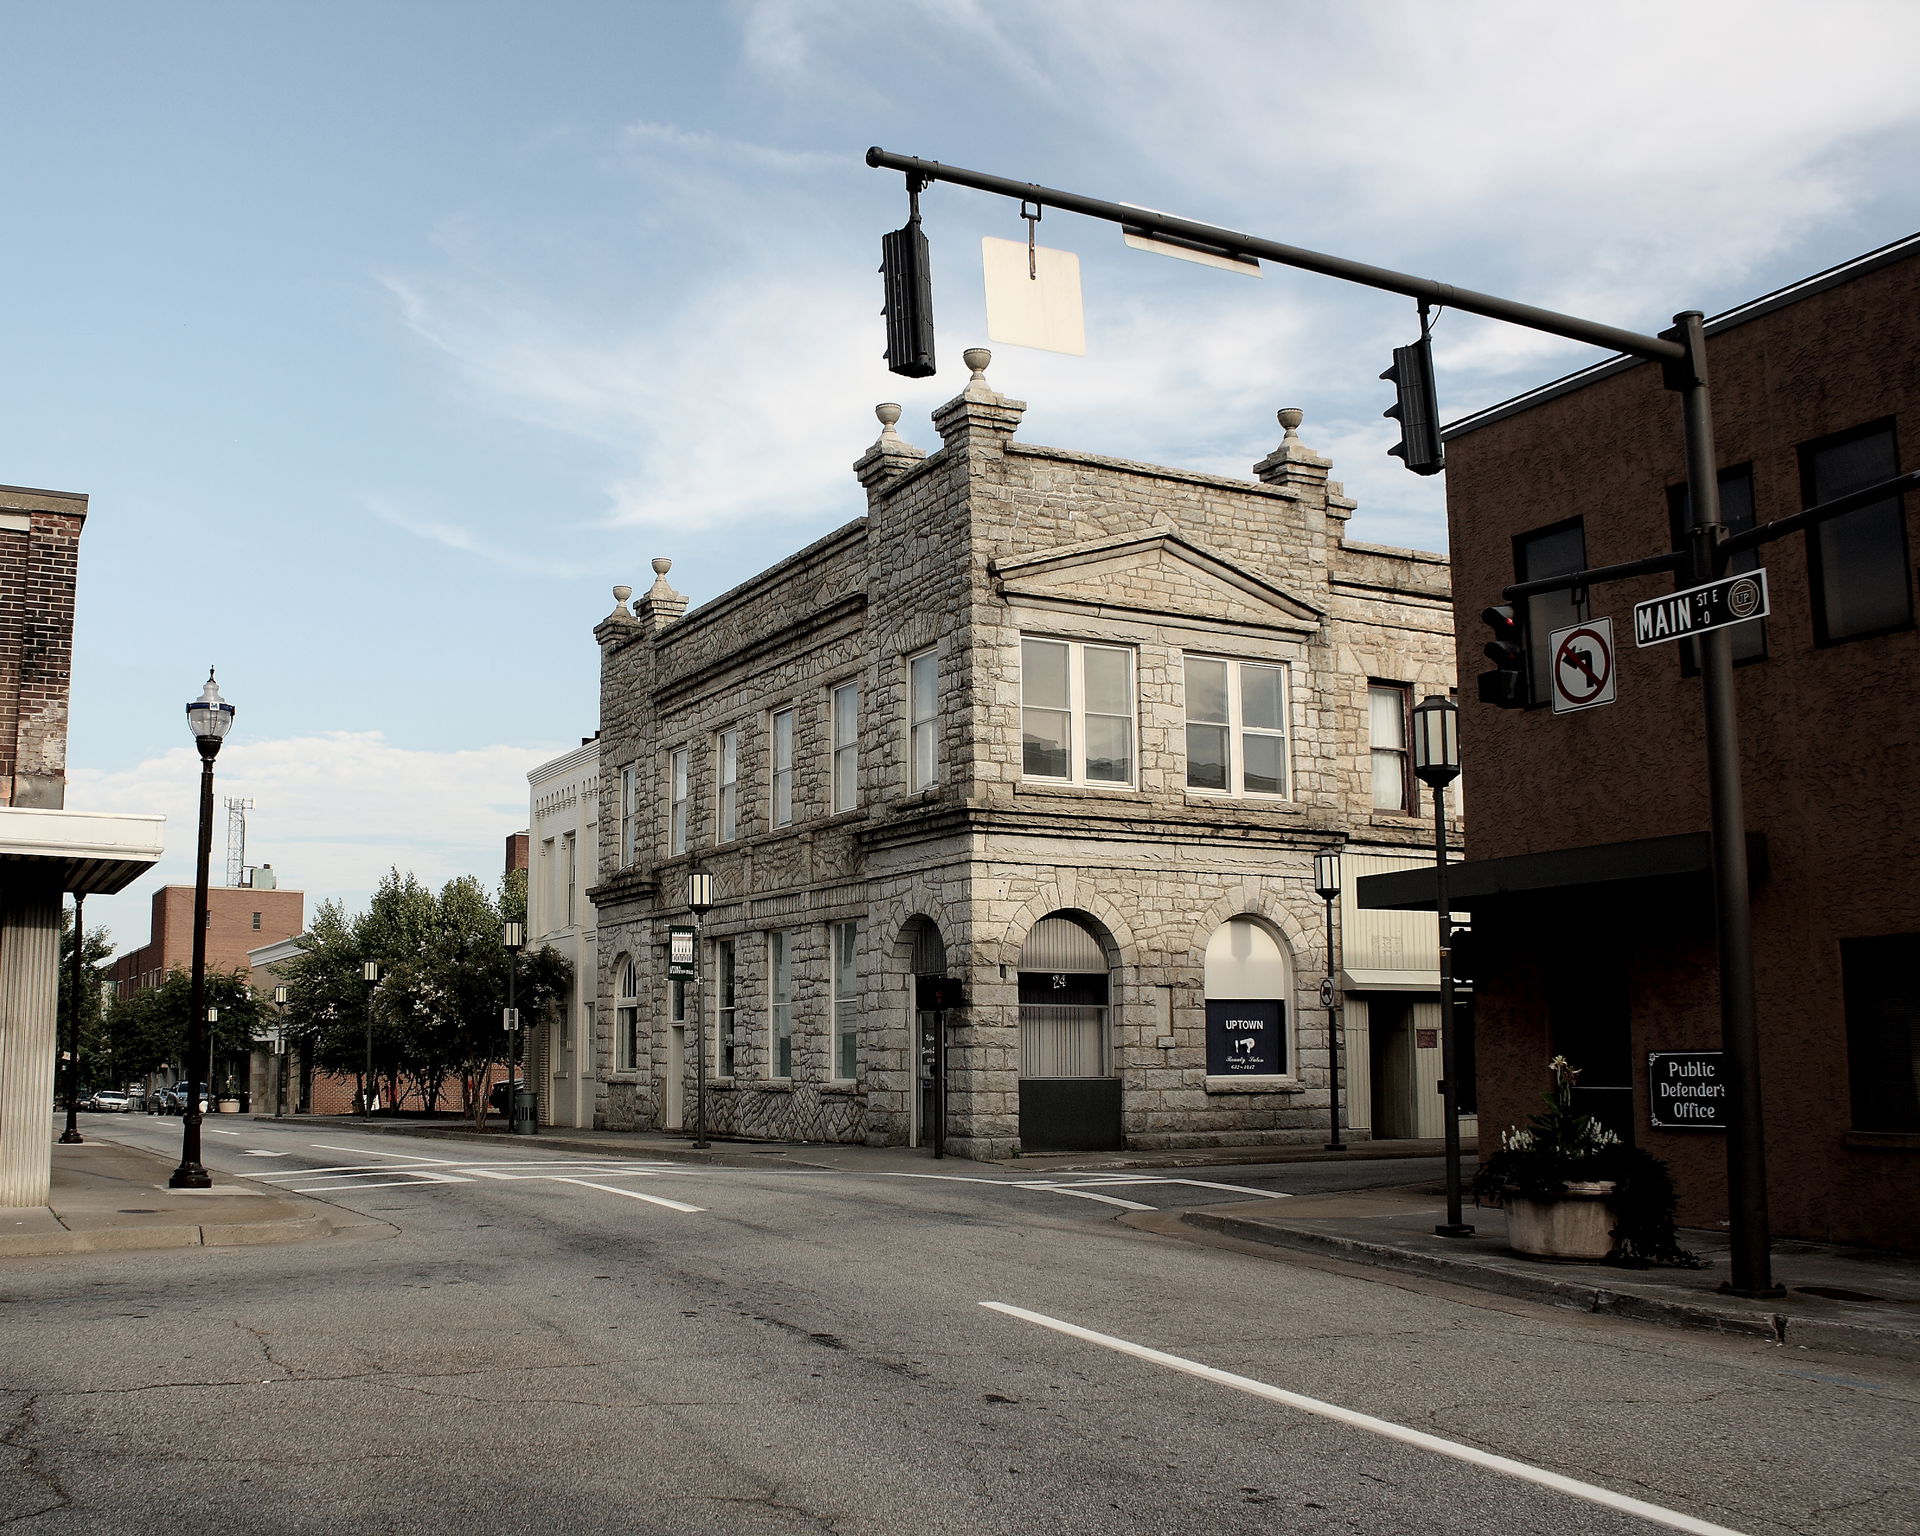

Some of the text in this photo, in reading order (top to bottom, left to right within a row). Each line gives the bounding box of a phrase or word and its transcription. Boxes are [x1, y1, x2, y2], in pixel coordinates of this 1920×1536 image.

[1638, 589, 1719, 641] MAIN ST E
[1225, 1020, 1264, 1030] UPTOWN
[1668, 1061, 1715, 1077] Public
[1673, 1102, 1716, 1118] Office
